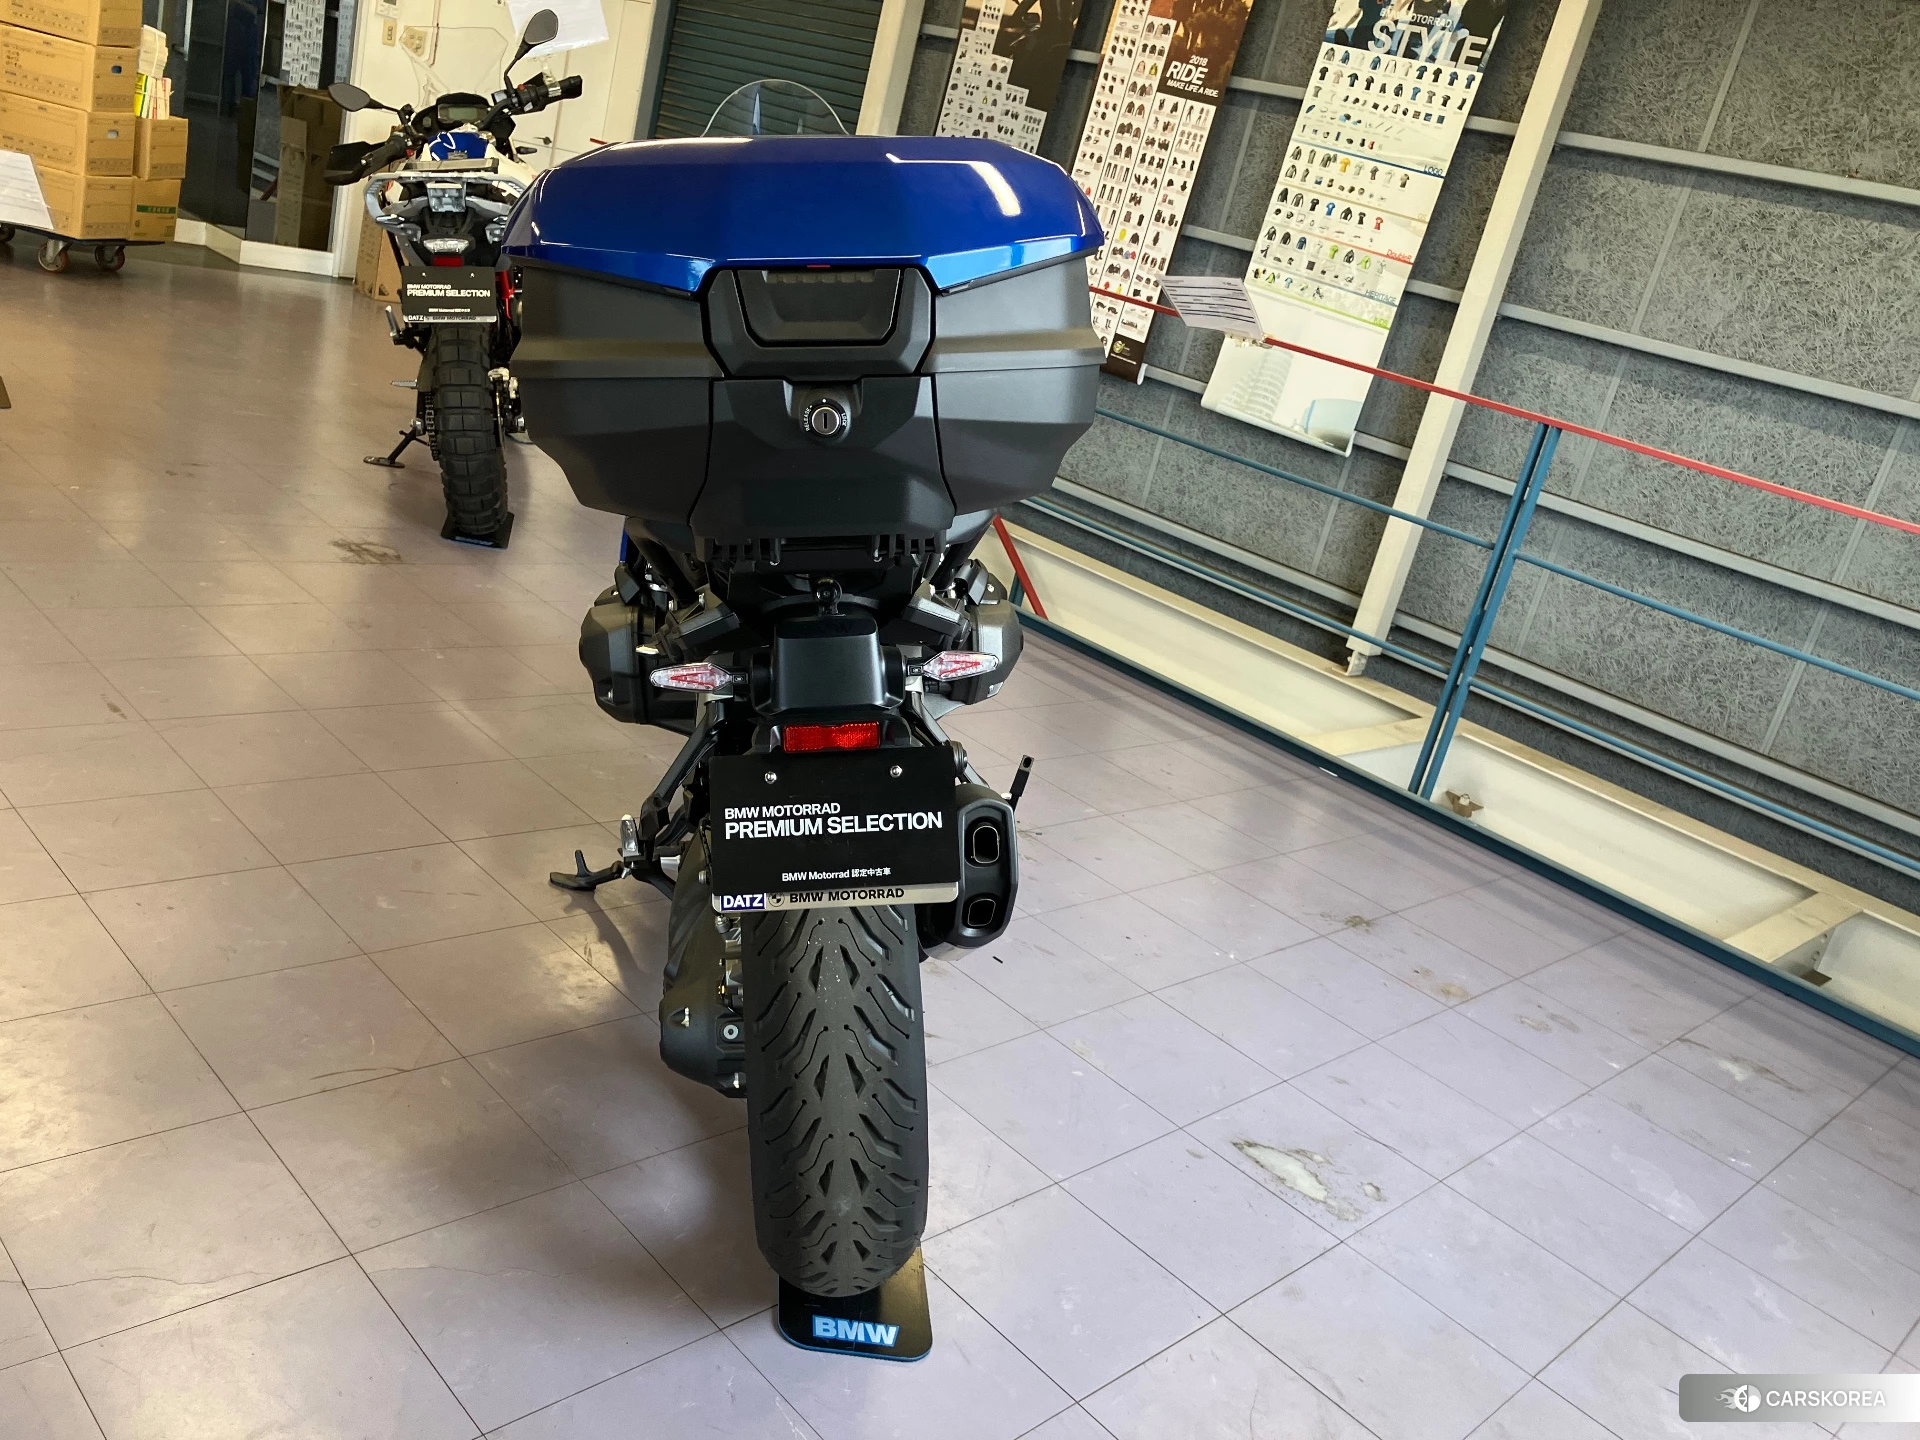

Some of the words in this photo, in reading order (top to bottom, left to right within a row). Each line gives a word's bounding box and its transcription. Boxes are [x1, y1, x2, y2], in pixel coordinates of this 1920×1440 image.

[1367, 19, 1488, 72] STYLE
[1189, 55, 1208, 66] 2018
[1166, 61, 1208, 85] RIDE
[1166, 79, 1185, 89] MAKE
[1185, 83, 1199, 93] LIFE
[1424, 165, 1443, 176] LOGO
[724, 806, 759, 820] BMW
[762, 802, 841, 818] MOTORRAD
[725, 817, 823, 840] PREMIUM
[827, 811, 943, 834] SELECTION
[781, 872, 807, 882] BMW
[808, 869, 850, 880] Motorrad
[851, 867, 892, 878] 認定中古車
[723, 893, 763, 909] DATZ
[789, 891, 824, 904] BMW
[828, 888, 905, 901] MOTORRAD
[813, 1315, 899, 1347] BMW
